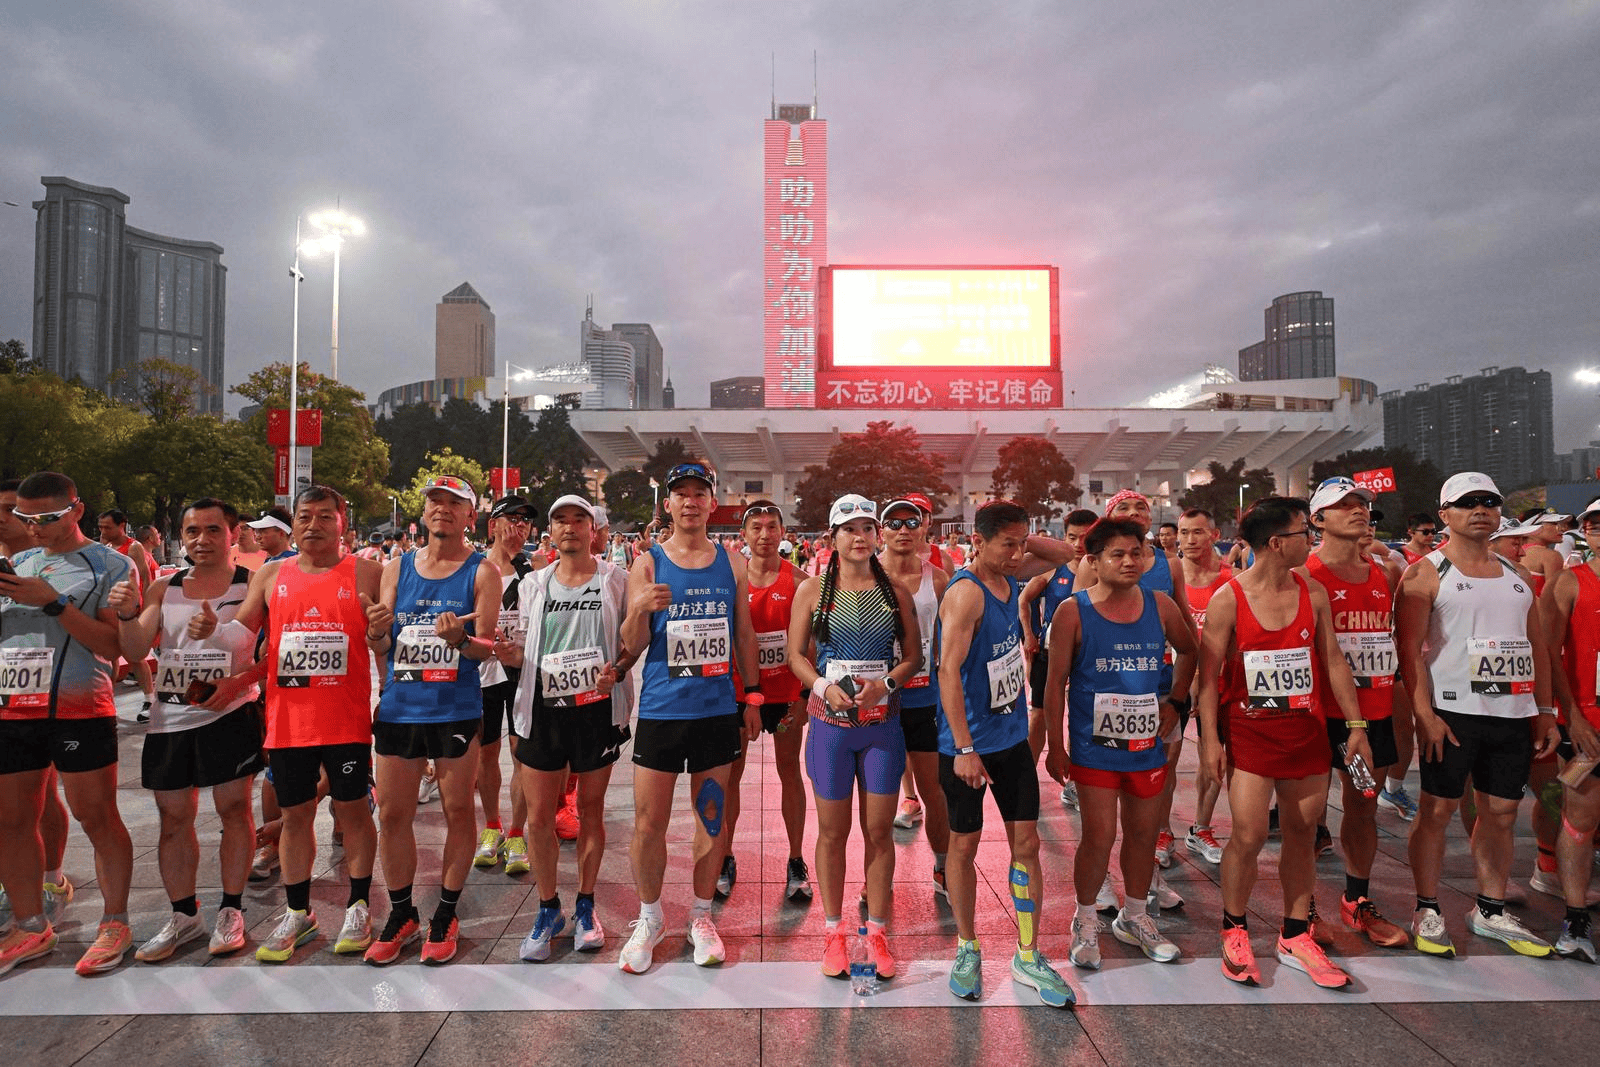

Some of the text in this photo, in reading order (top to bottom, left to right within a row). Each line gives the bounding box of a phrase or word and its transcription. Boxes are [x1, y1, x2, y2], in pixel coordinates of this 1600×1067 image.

[827, 378, 1053, 404] 不忘初心 牢记使命
[668, 601, 728, 619] 易方达基金
[398, 644, 454, 665] A2500
[673, 637, 727, 660] A1458
[282, 650, 342, 671] A2598
[1095, 656, 1158, 673] 易方达基金
[1345, 651, 1393, 671] A1117
[1477, 656, 1532, 676] A2193
[547, 665, 600, 693] A3610
[1254, 667, 1311, 691] A1955
[1099, 713, 1156, 734] A3635
